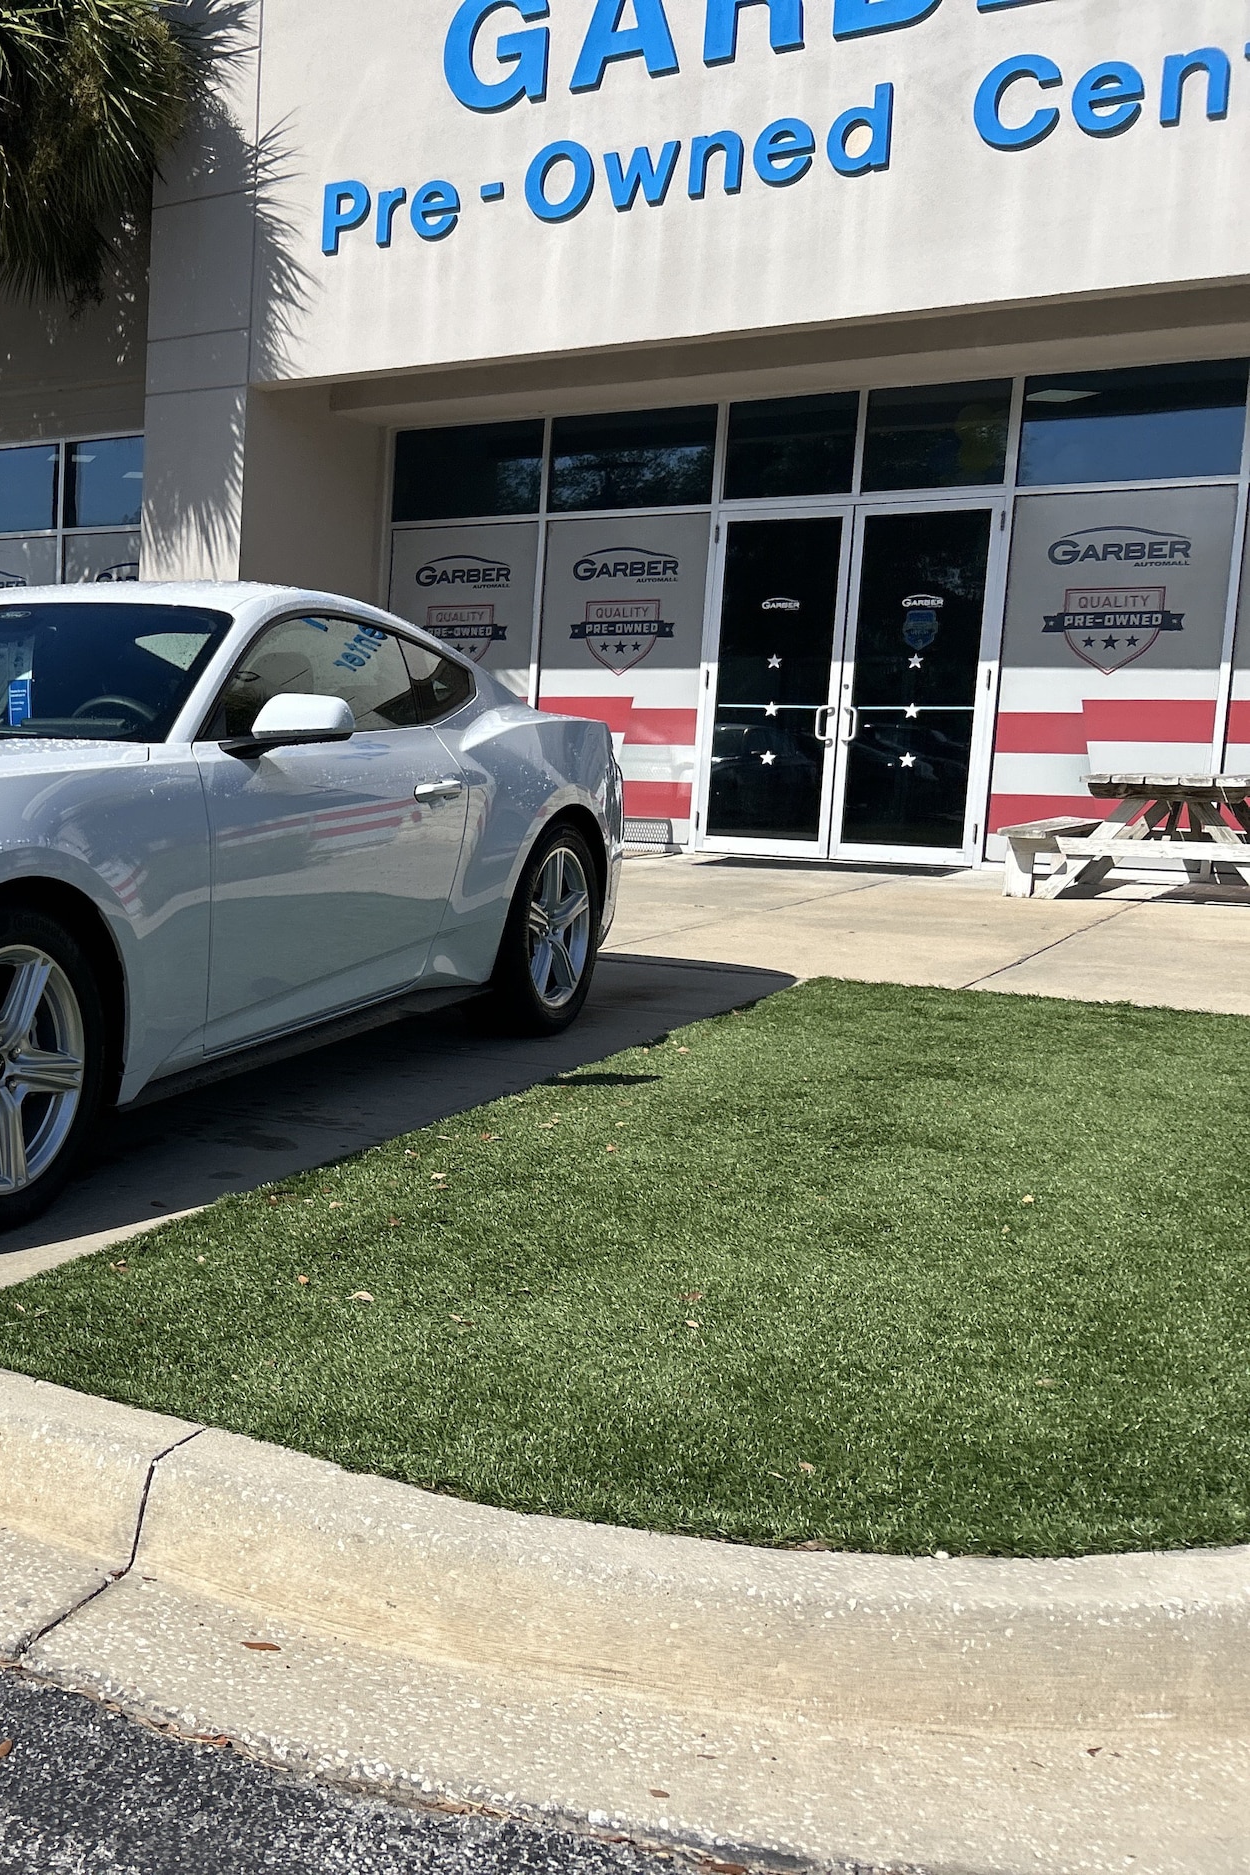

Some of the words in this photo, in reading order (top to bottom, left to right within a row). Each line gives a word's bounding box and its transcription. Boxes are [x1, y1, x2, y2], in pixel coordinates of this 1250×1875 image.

[973, 46, 1250, 152] Cen
[1048, 539, 1192, 566] GARBER
[415, 566, 511, 587] GARBER
[573, 559, 679, 581] GARBER
[761, 601, 800, 610] GARBER
[902, 598, 944, 608] GARBER
[1078, 595, 1150, 609] QUALITY
[436, 611, 484, 622] QUALITY
[595, 607, 649, 619] QUALITY
[1063, 613, 1163, 627] PRE-OWNED
[585, 623, 659, 634] PRE-OWNED
